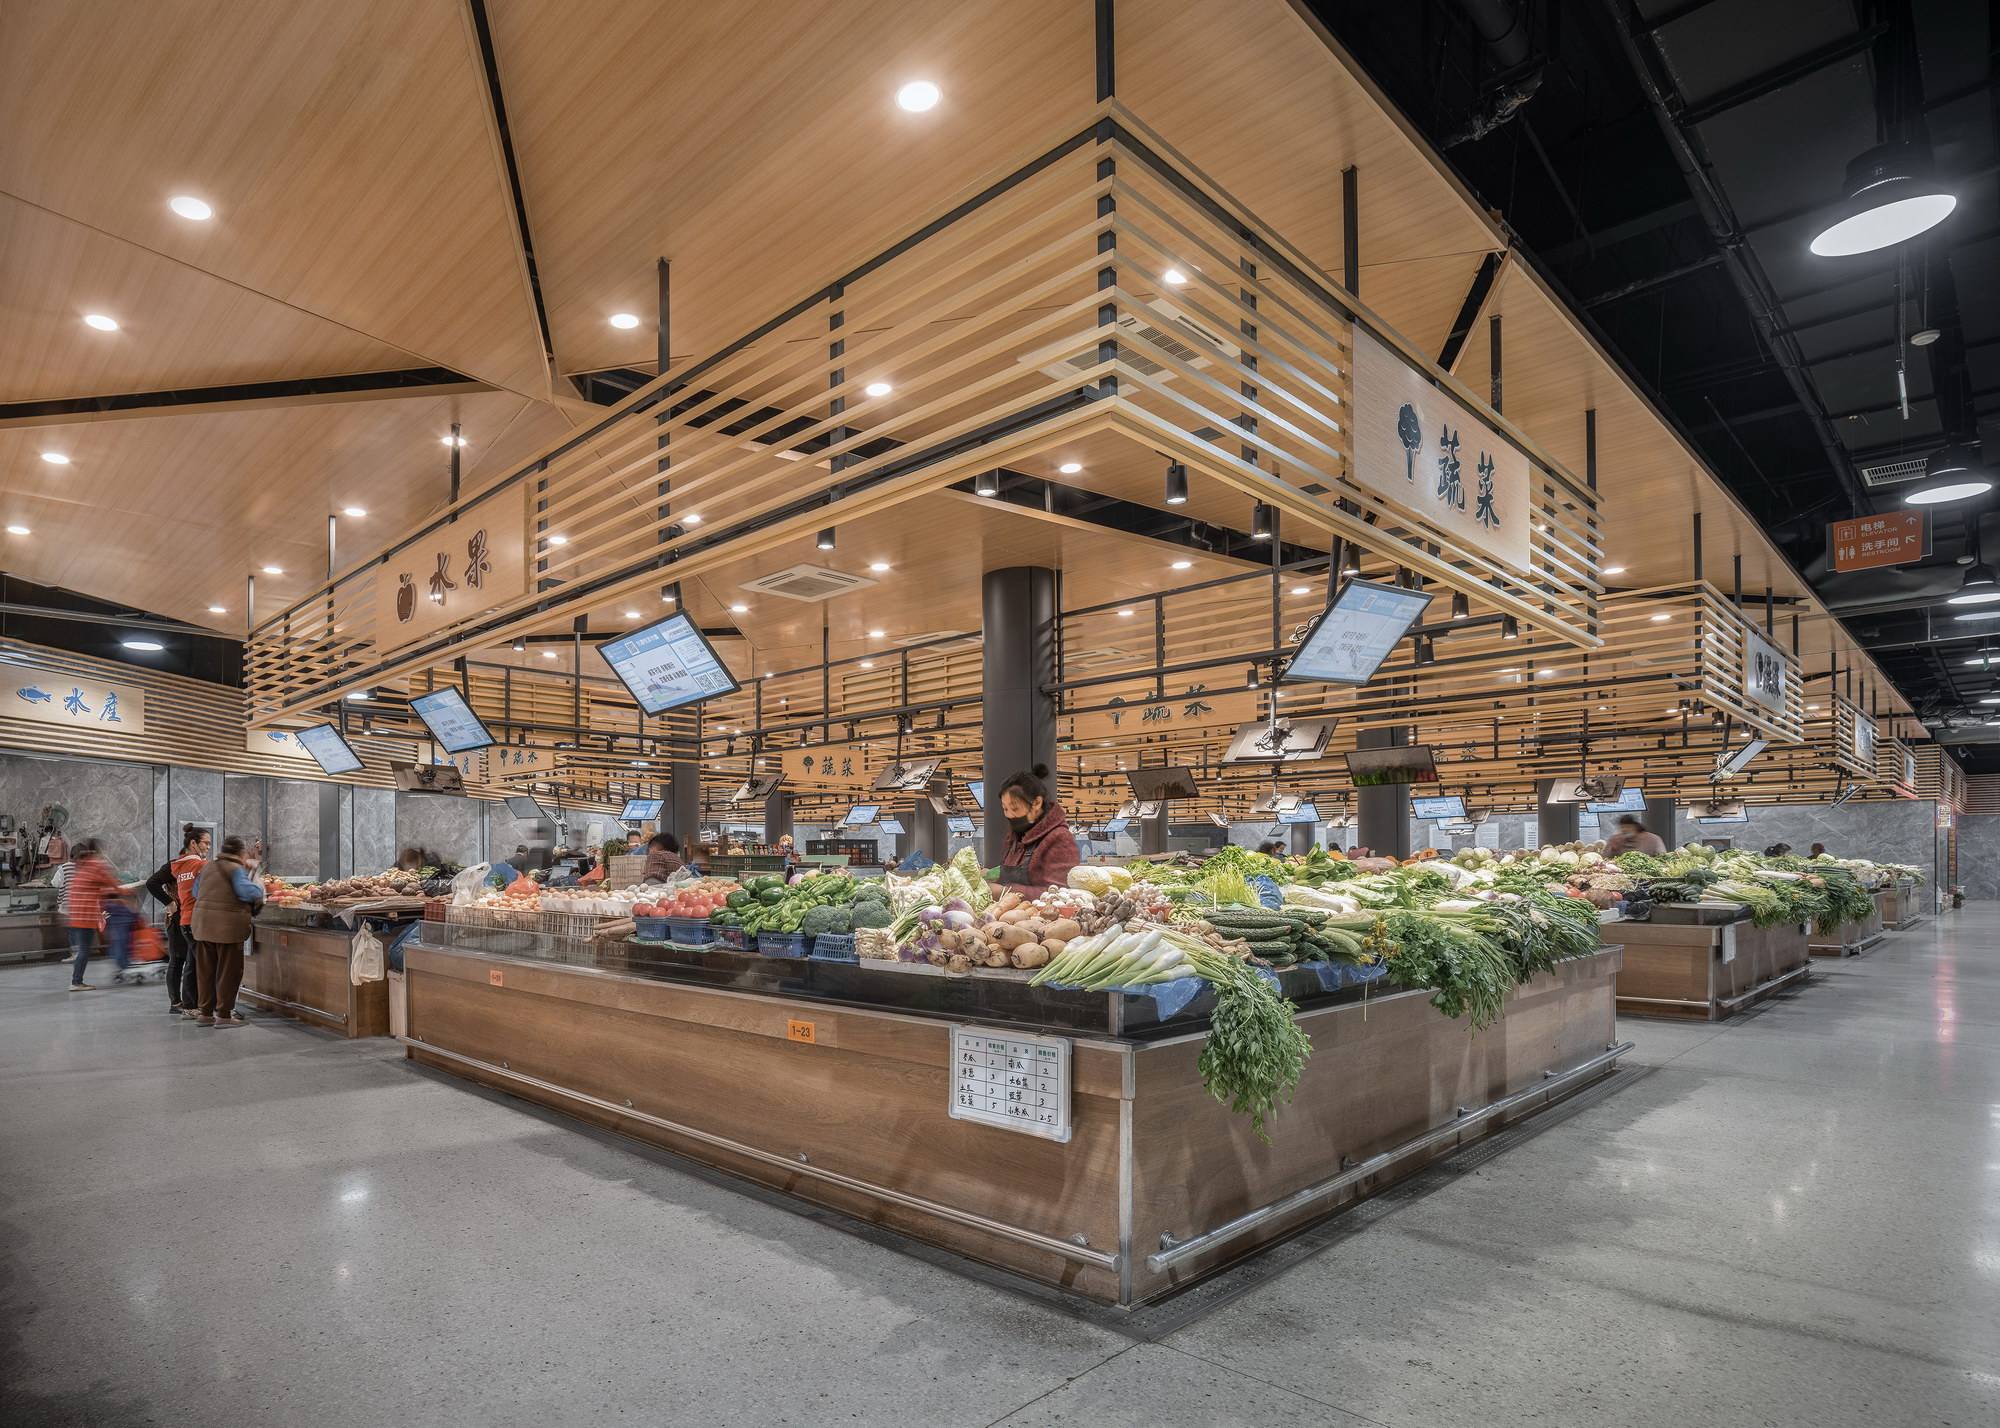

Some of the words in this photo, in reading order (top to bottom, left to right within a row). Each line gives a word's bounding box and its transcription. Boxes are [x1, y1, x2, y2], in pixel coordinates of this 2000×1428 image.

[1437, 424, 1500, 528] 蔬菜
[1861, 521, 1885, 531] 电梯
[1861, 527, 1898, 537] ELEVATOR
[1861, 537, 1899, 552] 洗手间
[1861, 546, 1901, 558] RESTROOM
[429, 529, 490, 606] 水果
[822, 756, 854, 777] 蔬菜
[791, 1025, 810, 1038] 1-23
[1043, 1067, 1049, 1075] 2
[1041, 1083, 1047, 1091] 2
[991, 1101, 998, 1109] 5
[1039, 1097, 1045, 1107] 3
[1040, 1114, 1052, 1123] 2.5
